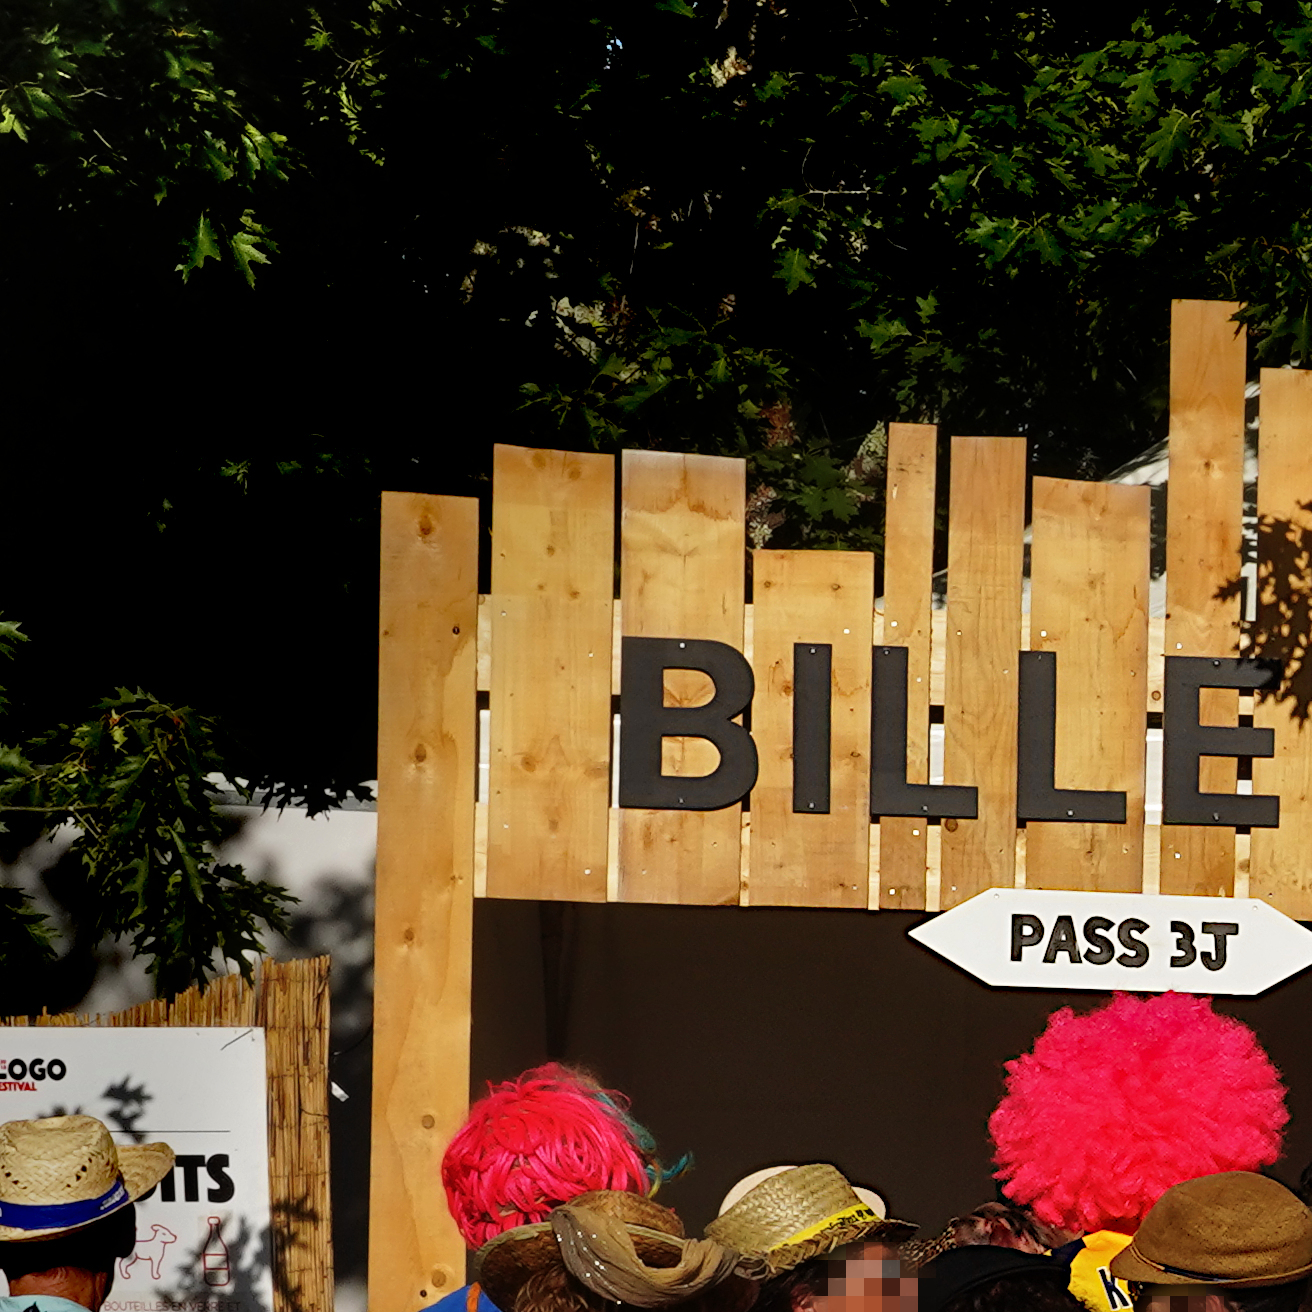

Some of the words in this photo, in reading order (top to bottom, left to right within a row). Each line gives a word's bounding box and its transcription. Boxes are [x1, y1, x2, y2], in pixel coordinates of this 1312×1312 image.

[1010, 913, 1150, 968] PASS
[1170, 920, 1239, 971] 3J
[134, 1154, 235, 1203] ITS
[104, 1301, 169, 1312] BOUTEILLES
[227, 1302, 241, 1312] ET
